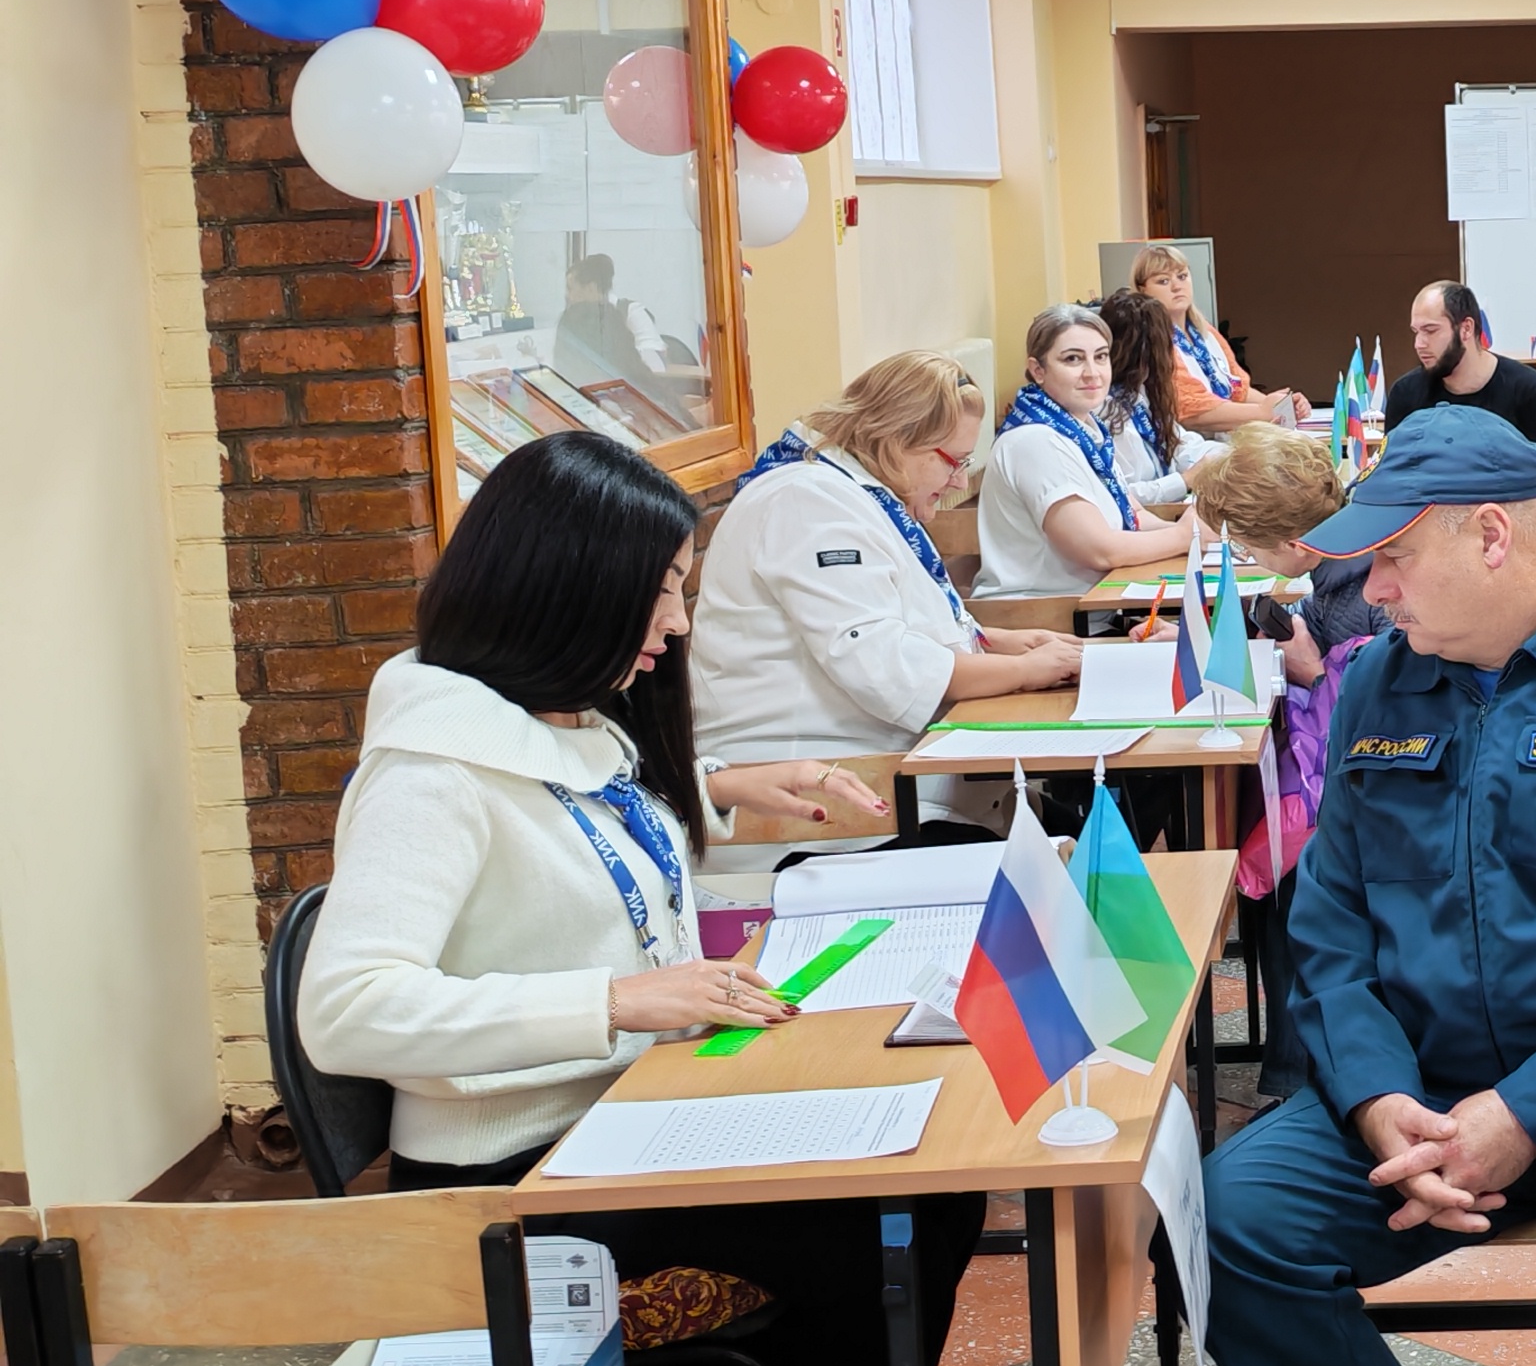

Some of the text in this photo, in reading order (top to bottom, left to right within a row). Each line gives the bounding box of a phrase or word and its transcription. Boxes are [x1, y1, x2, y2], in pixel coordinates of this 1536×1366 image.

[782, 433, 804, 449] УИК
[894, 504, 915, 532] УИК
[589, 829, 620, 870] УИК
[624, 885, 646, 928] УИК
